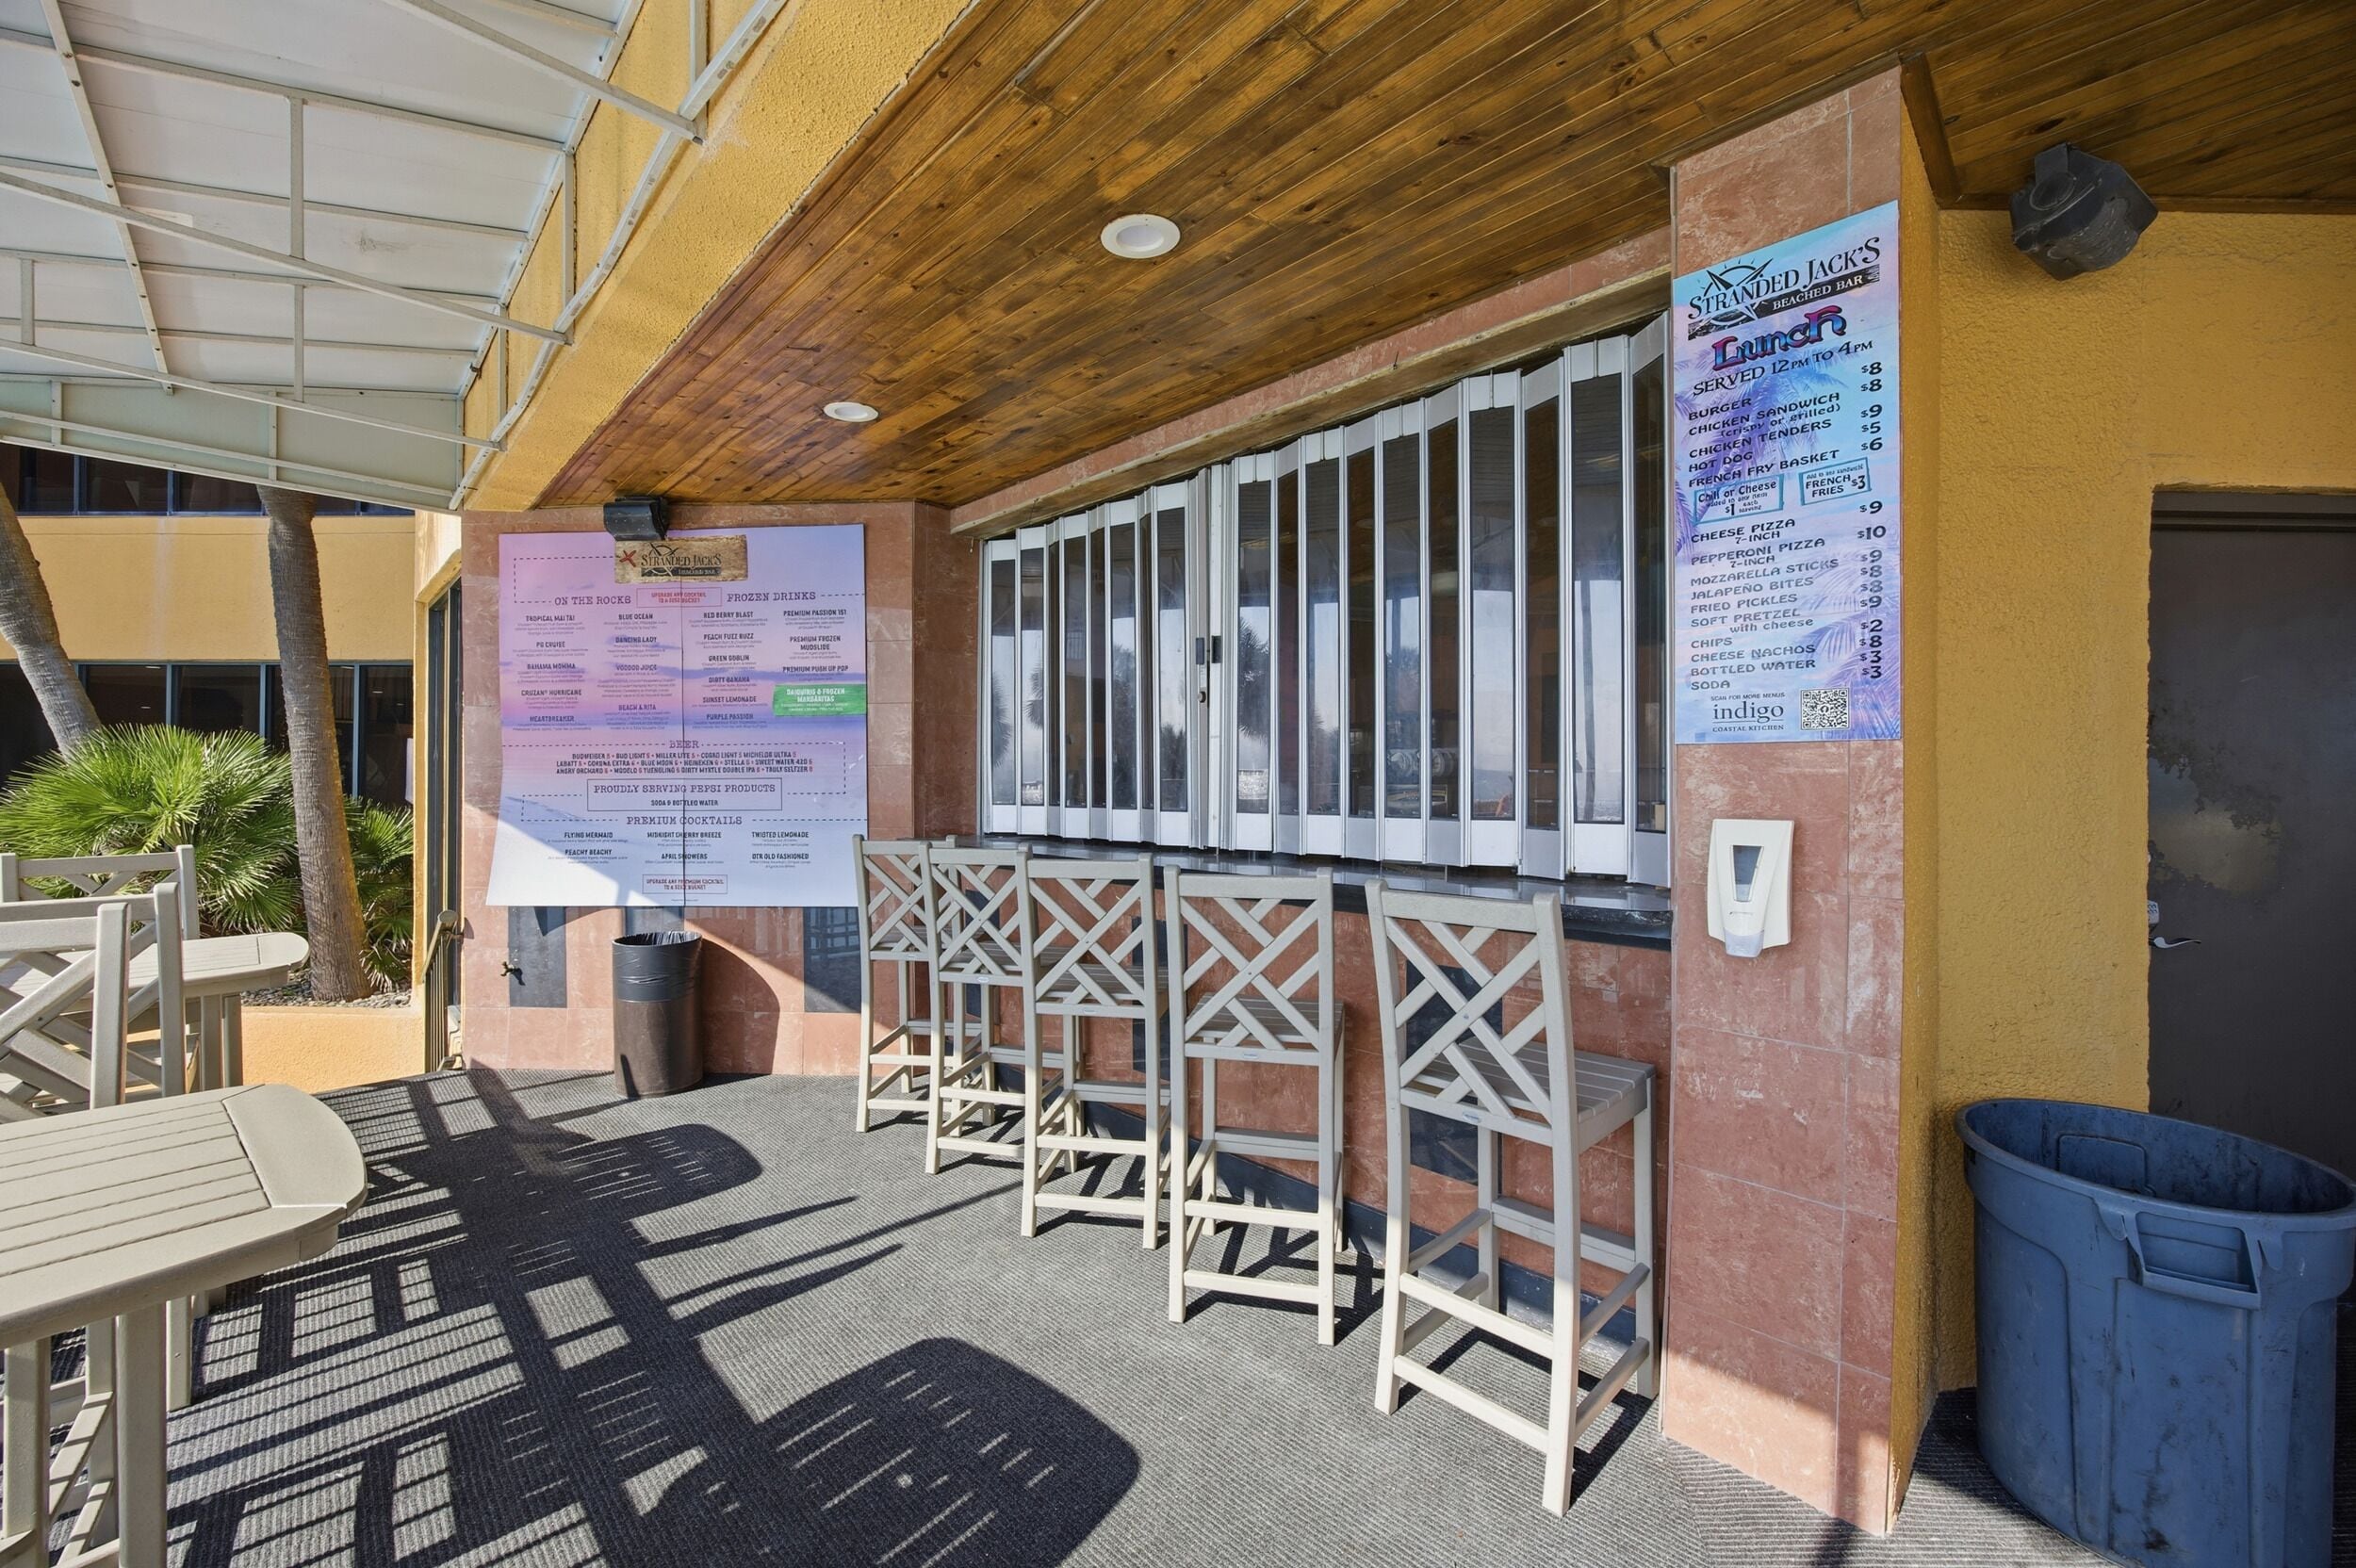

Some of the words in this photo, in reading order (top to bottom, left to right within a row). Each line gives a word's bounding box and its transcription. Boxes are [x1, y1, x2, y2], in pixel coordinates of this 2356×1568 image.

[1688, 270, 1799, 319] STRANDED
[1803, 237, 1880, 291] JACK'S
[1773, 285, 1831, 311] BEACHED
[1836, 275, 1863, 291] BAR
[1712, 305, 1846, 370] Lunch
[1693, 366, 1765, 397] SERVED
[1813, 350, 1833, 363] TO
[1689, 399, 1751, 421] BURGER
[1861, 362, 1883, 375] $8
[1689, 415, 1750, 436] CHICKEN
[1756, 393, 1840, 419] SANDWICH
[1861, 379, 1883, 392] $8
[1721, 422, 1764, 438] (crispy
[1770, 416, 1784, 427] or
[1790, 403, 1841, 422] grilled)
[1690, 438, 1752, 459] CHICKEN
[1760, 419, 1832, 443] TENDERS
[1861, 404, 1883, 418] $9
[1689, 460, 1717, 472] HOT
[1723, 452, 1753, 465] DOG
[1861, 421, 1881, 433] $5
[1689, 471, 1742, 487] FRENCH
[1748, 463, 1775, 476] FRY
[1779, 449, 1840, 468] BASKET
[1861, 437, 1883, 450] $6
[1724, 489, 1735, 498] or
[1739, 482, 1776, 495] Cheese
[1806, 474, 1850, 489] FRENCH
[1852, 475, 1865, 489] $3
[1811, 485, 1844, 498] FRIES
[1692, 527, 1744, 543] CHEESE
[1751, 519, 1795, 532] PIZZA
[1859, 501, 1883, 514] $9
[1726, 504, 1734, 515] $1
[1692, 547, 1771, 565] PEPPERONI
[1779, 538, 1824, 552] PIZZA
[1857, 526, 1886, 540] $10
[1735, 531, 1780, 544] 7-INCH
[641, 554, 691, 567] STRANDED
[694, 553, 722, 567] JACK'S
[1691, 565, 1780, 586] MOZZARELLA
[1786, 559, 1839, 573] STICKS
[1860, 549, 1882, 564] $9
[1730, 555, 1775, 568] 7-INCH
[1691, 583, 1763, 600] JALAPEÑO
[1770, 577, 1814, 591] BITES
[1860, 564, 1883, 578] $8
[1691, 601, 1731, 613] FRIED
[1737, 594, 1798, 609] PICKLES
[1860, 580, 1883, 593] $8
[555, 596, 567, 606] ON
[571, 596, 593, 605] THE
[597, 596, 631, 605] ROCKS
[727, 593, 769, 602] FROZEN
[773, 592, 816, 601] DRINKS
[1691, 615, 1727, 628] SOFT
[1733, 609, 1801, 623] PRETZEL
[1860, 596, 1882, 609] $9
[1730, 624, 1757, 634] with
[1763, 619, 1813, 630] cheese
[1691, 637, 1733, 648] CHIPS
[1860, 619, 1883, 633] $2
[1691, 650, 1744, 662] CHEESE
[1751, 645, 1816, 659] NACHOS
[1859, 635, 1883, 648] $8
[1691, 663, 1756, 677] BOTTLED
[1761, 660, 1816, 671] WATER
[1859, 650, 1882, 663] $3
[1691, 680, 1730, 691] SODA
[1861, 665, 1882, 679] $3
[1713, 701, 1784, 723] indigo
[594, 785, 639, 793] PROUDLY
[725, 784, 776, 792] PRODUCTS
[679, 816, 743, 825] COCKTAILS
